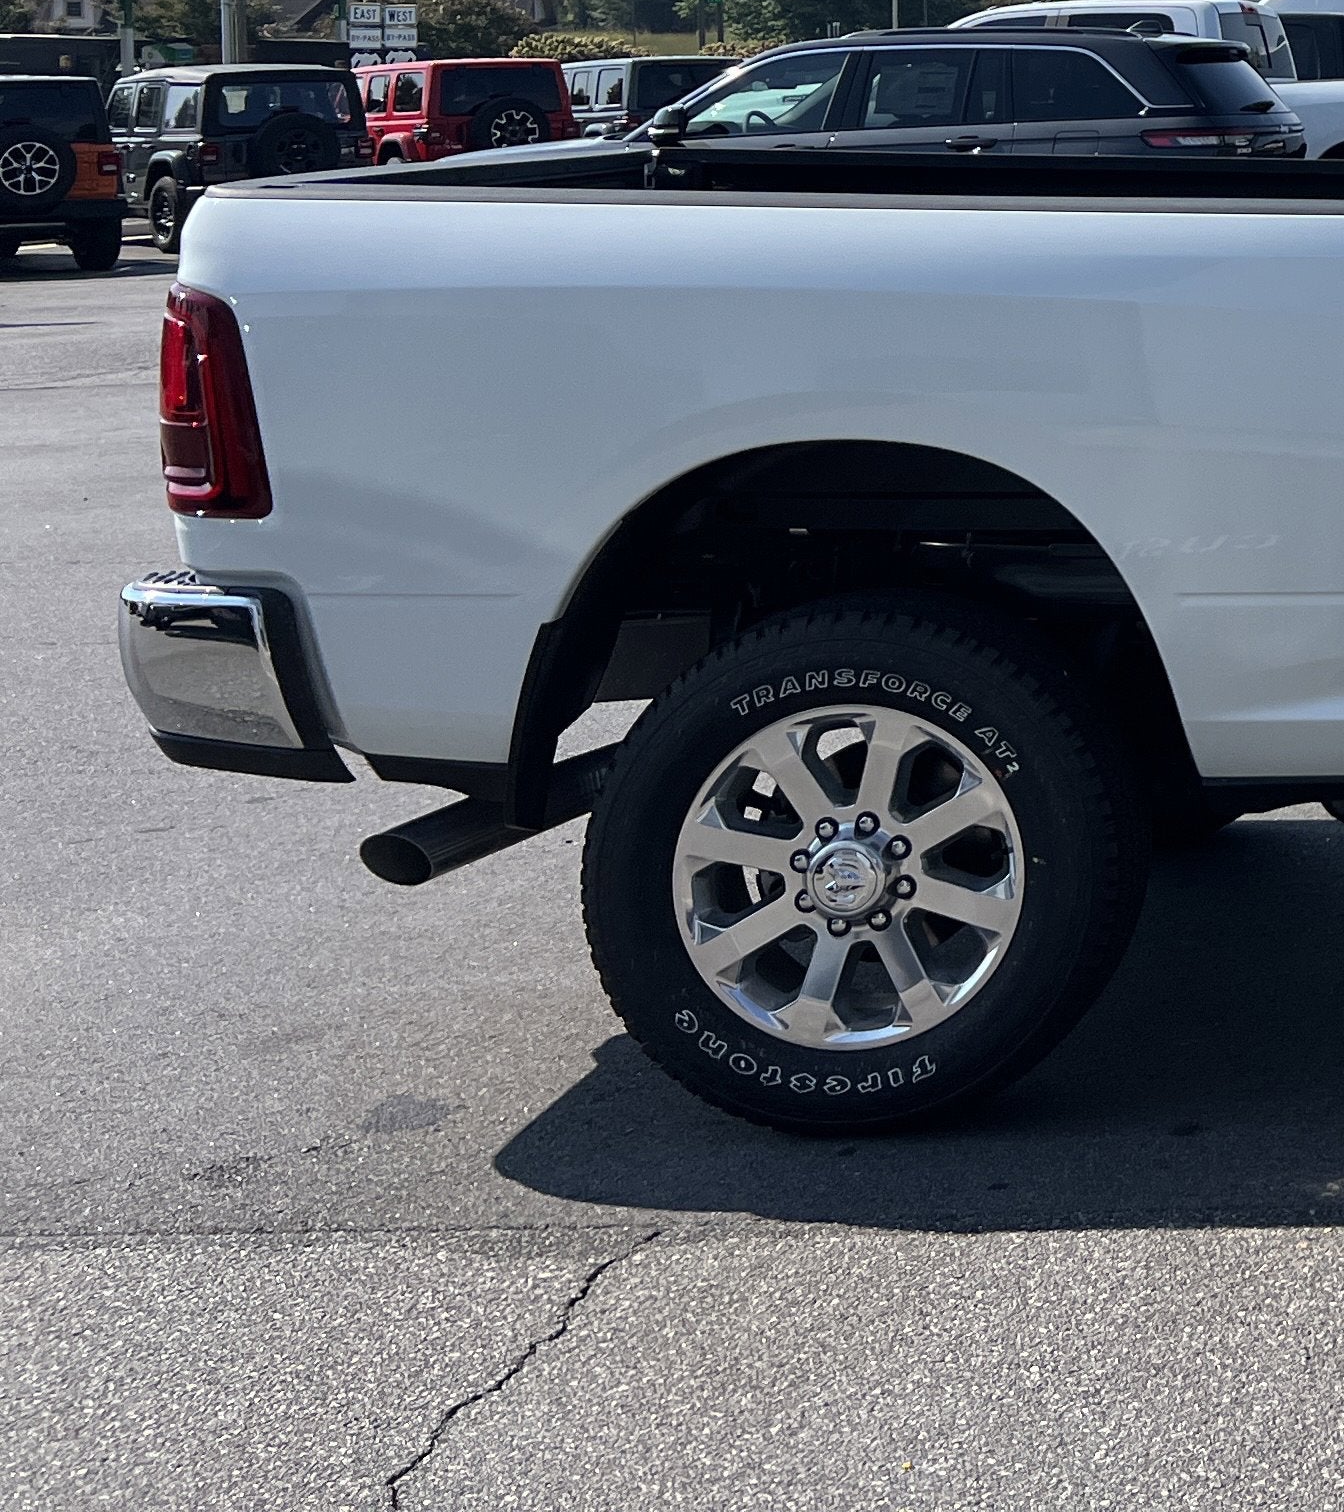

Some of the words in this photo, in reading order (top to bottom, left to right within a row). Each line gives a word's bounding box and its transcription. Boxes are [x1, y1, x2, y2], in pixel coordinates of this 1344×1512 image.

[353, 7, 377, 20] EAST
[388, 10, 413, 22] WEST
[730, 668, 973, 723] TRANSFORCE
